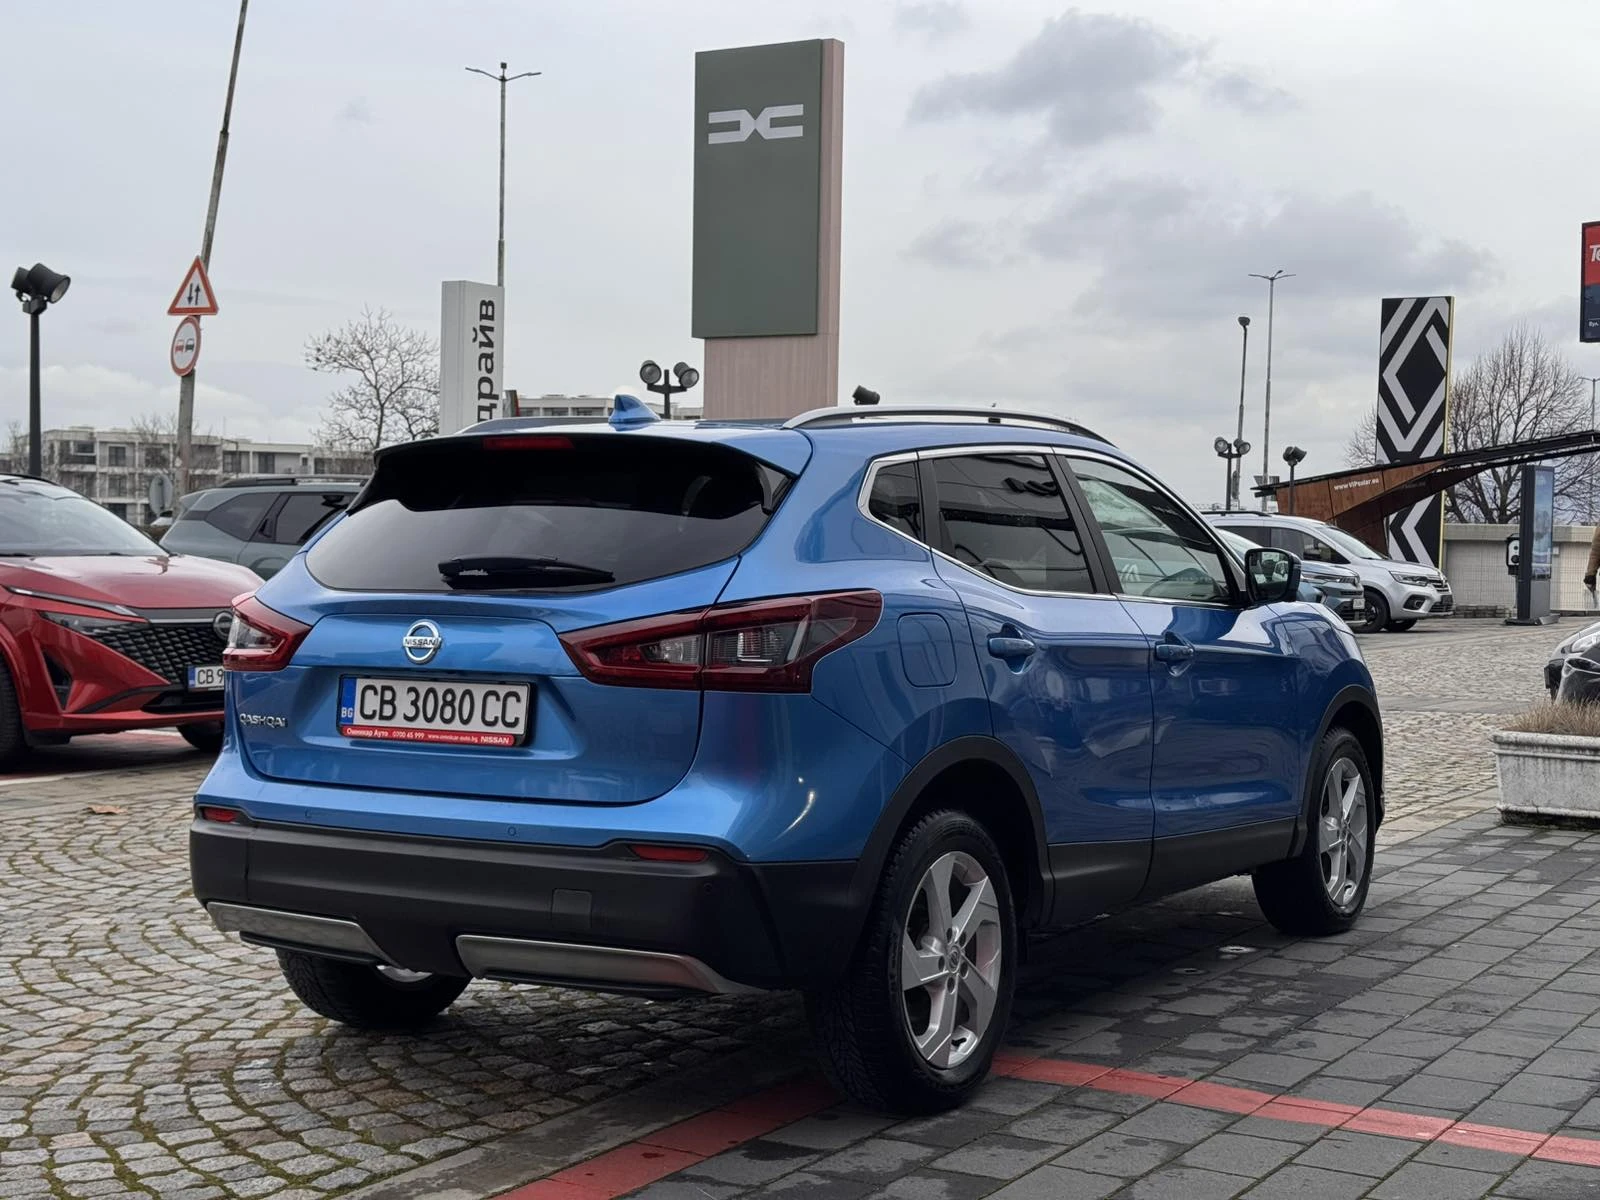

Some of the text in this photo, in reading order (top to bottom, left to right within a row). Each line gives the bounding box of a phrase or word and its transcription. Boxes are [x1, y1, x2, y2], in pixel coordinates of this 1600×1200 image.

[404, 638, 436, 647] NISSAN
[198, 669, 214, 685] CB
[341, 706, 354, 719] BG
[360, 684, 521, 729] CB 3080 CC
[480, 735, 510, 745] NISSAN
